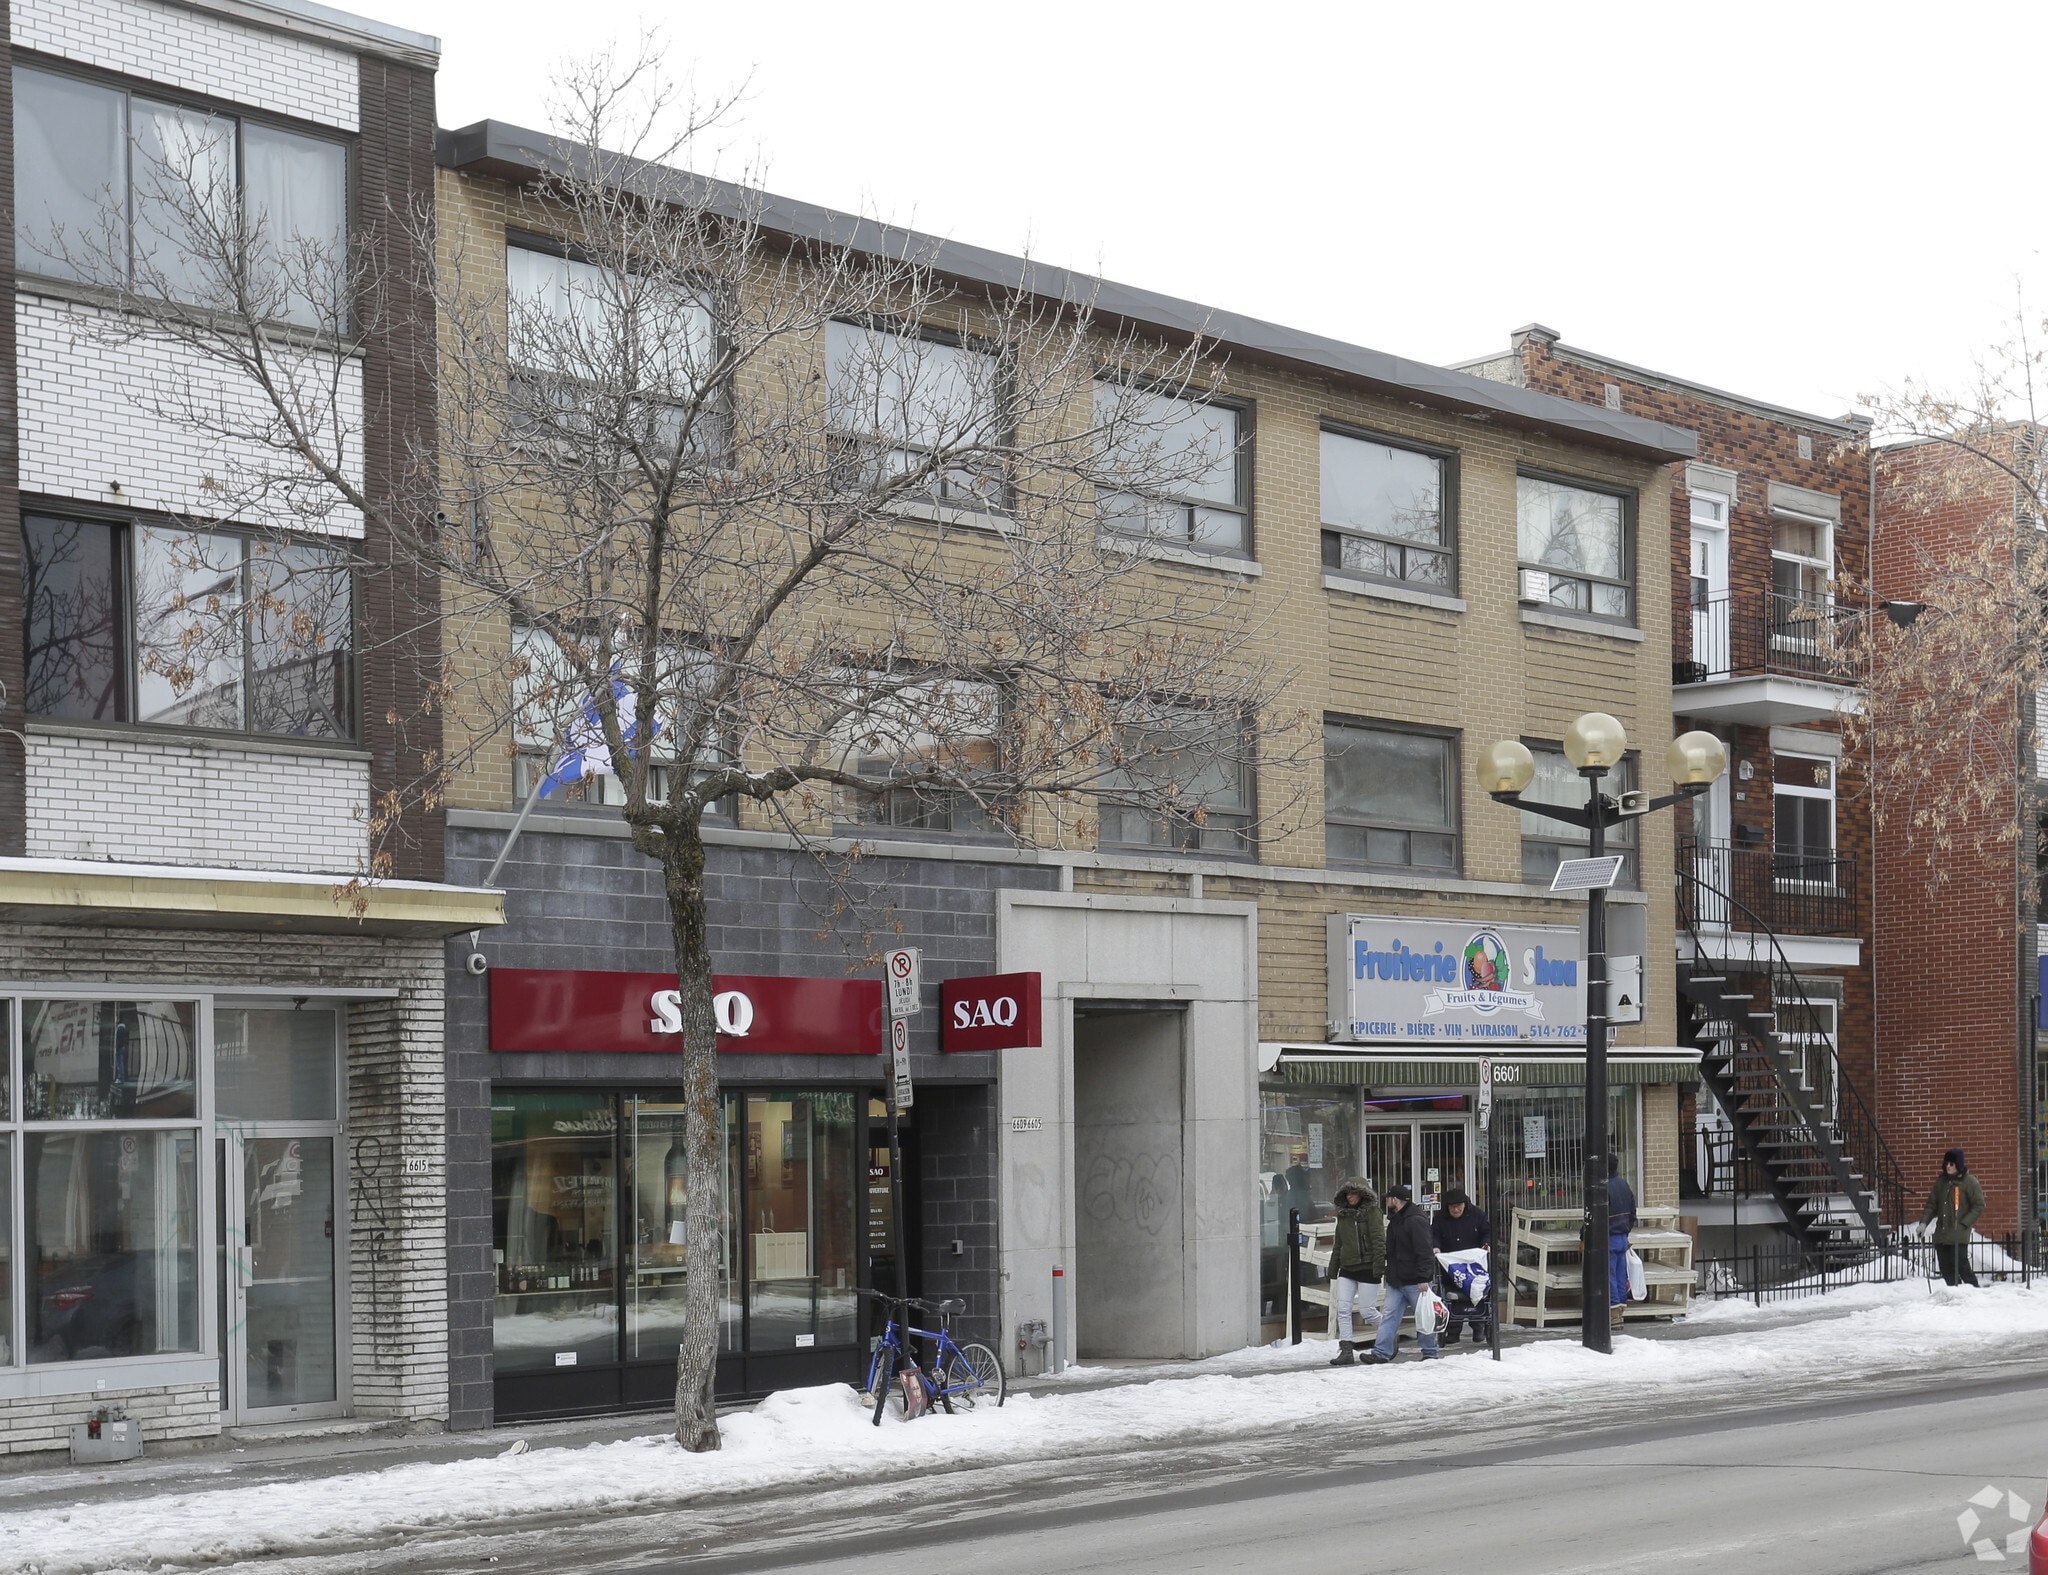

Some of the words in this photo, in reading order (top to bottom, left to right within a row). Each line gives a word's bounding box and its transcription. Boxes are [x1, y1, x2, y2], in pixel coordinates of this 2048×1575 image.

[1355, 938, 1457, 982] Fruiterie
[895, 986, 913, 997] LUNDI
[1447, 993, 1476, 1003] Fruits
[1478, 992, 1486, 1002] &
[1488, 992, 1527, 1005] légumes
[650, 989, 754, 1037] SQ
[953, 996, 1018, 1030] SAQ
[1444, 1024, 1462, 1036] VIN
[1471, 1024, 1518, 1037] LIVRAISON
[1493, 1066, 1520, 1082] 6601
[1012, 1119, 1026, 1130] 6609
[1027, 1119, 1042, 1129] 6605
[409, 1160, 427, 1171] 6615
[869, 1168, 884, 1176] SAQ
